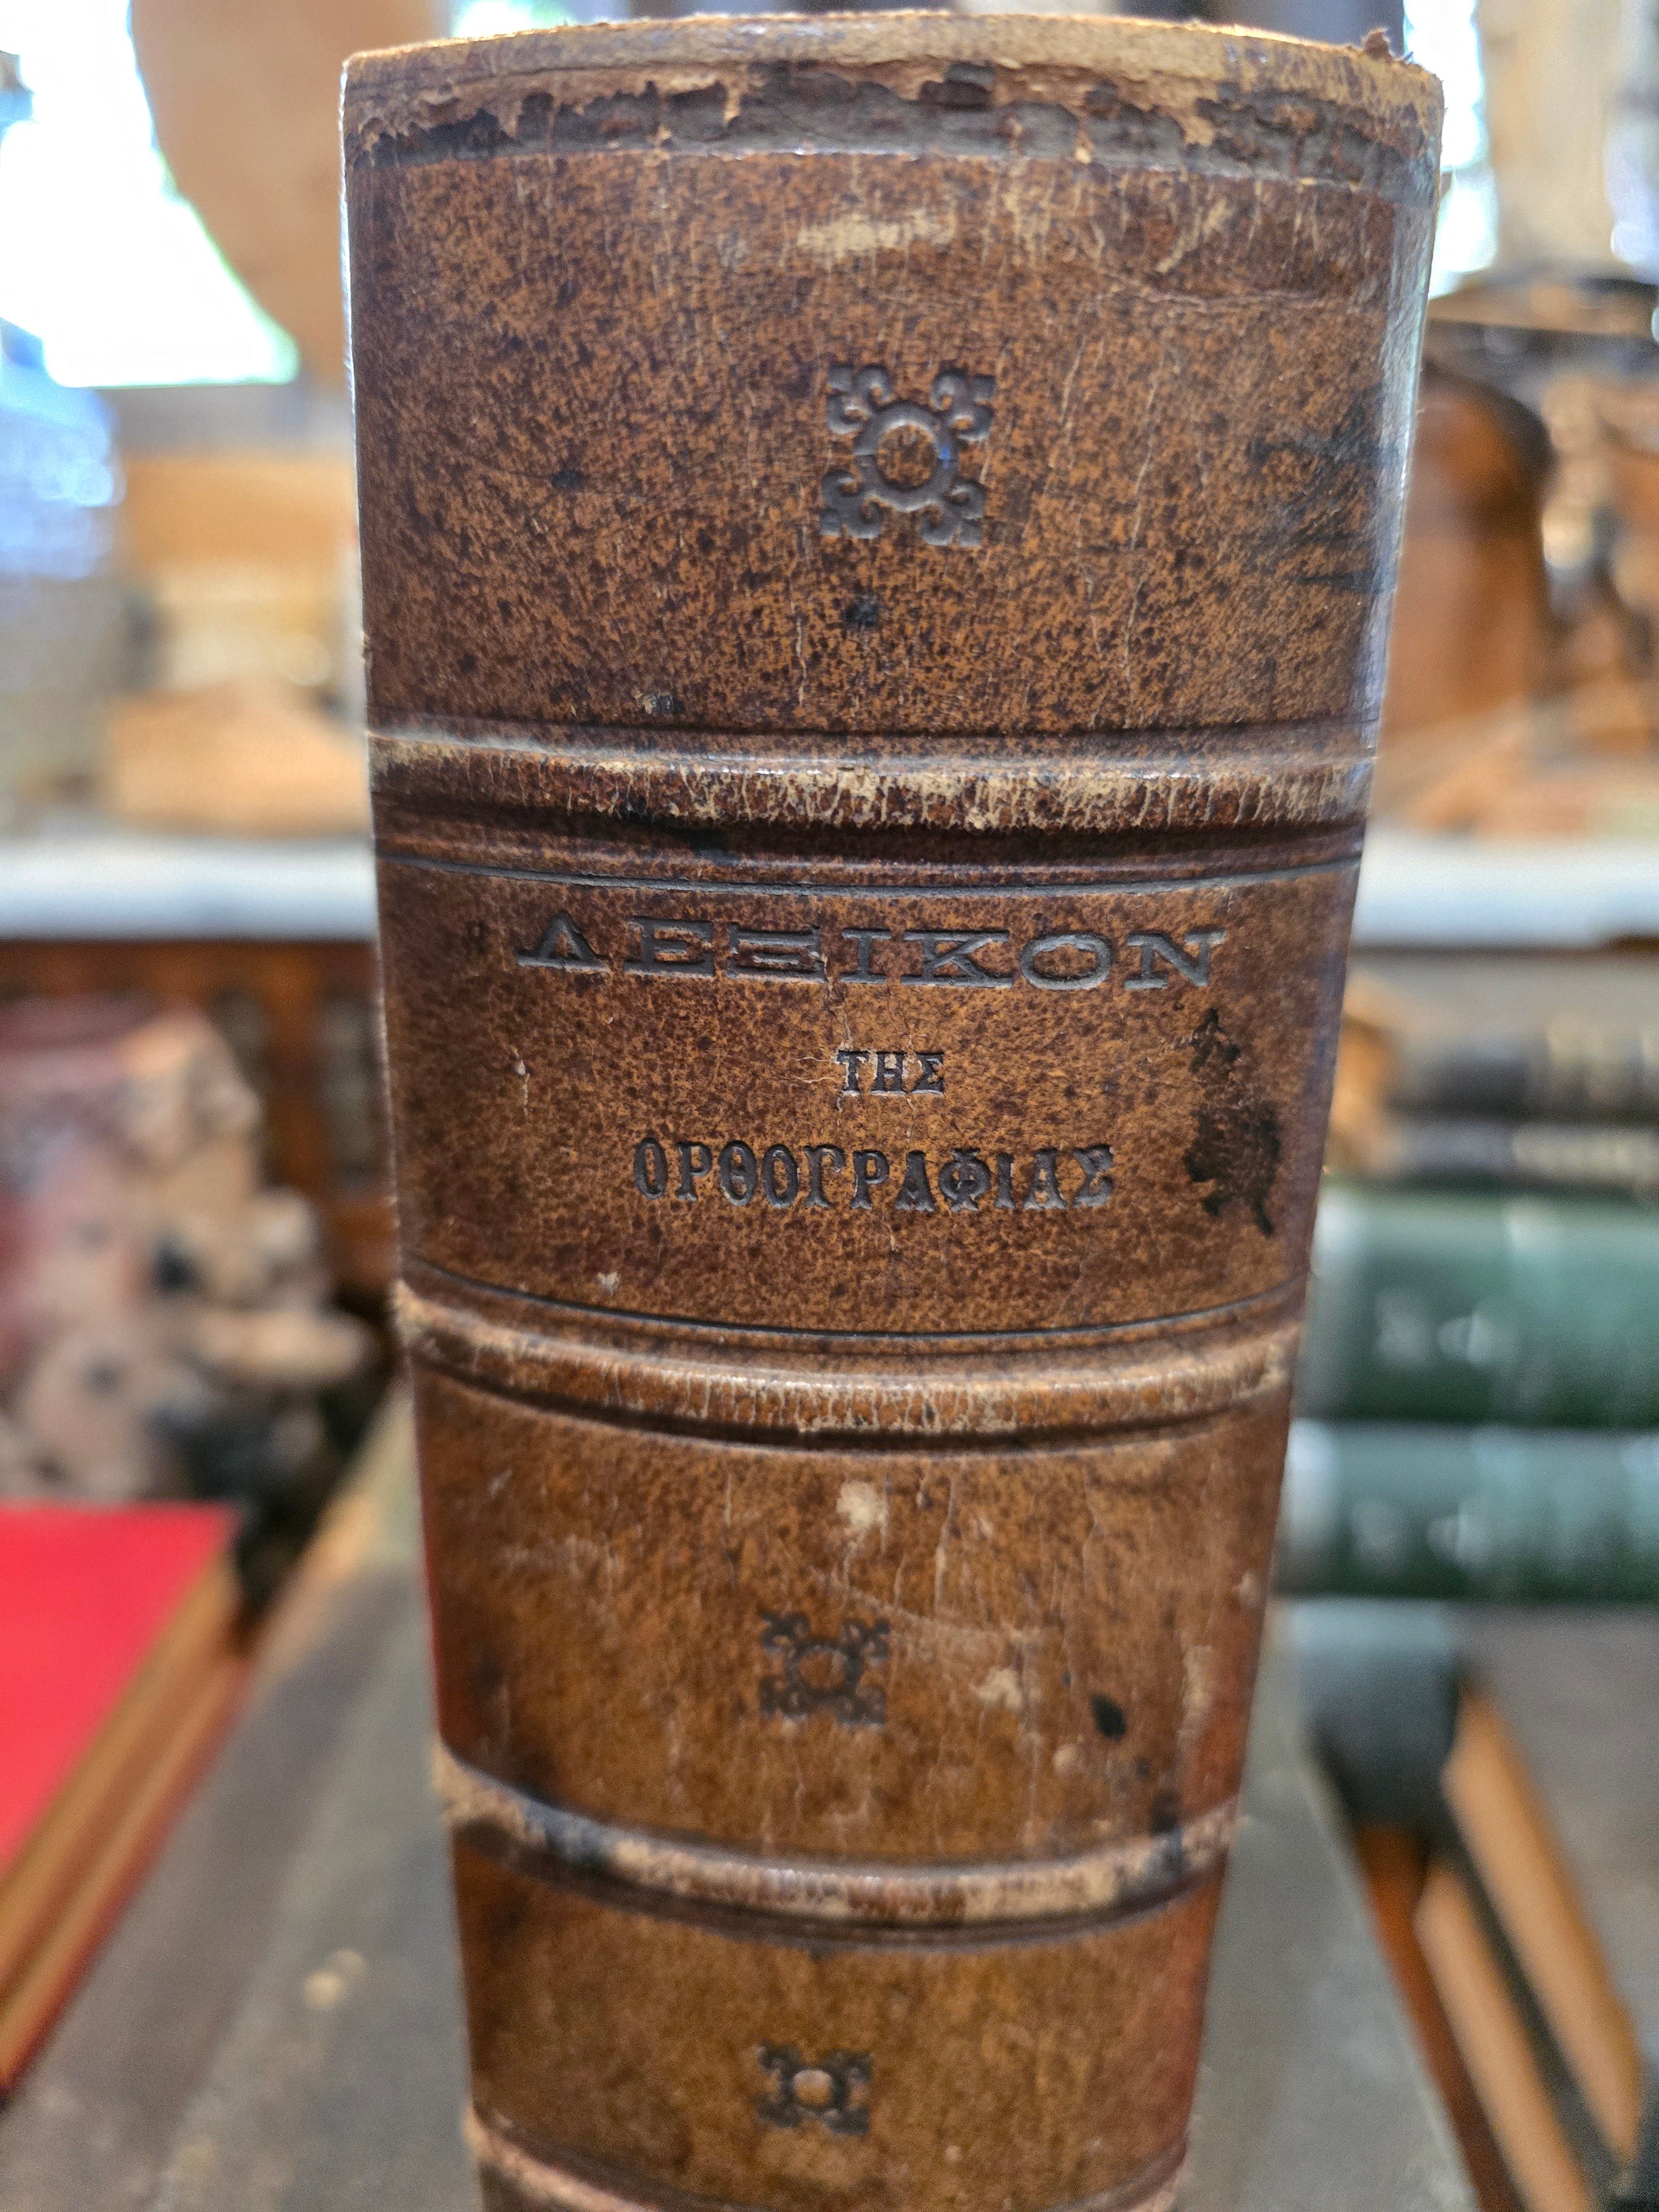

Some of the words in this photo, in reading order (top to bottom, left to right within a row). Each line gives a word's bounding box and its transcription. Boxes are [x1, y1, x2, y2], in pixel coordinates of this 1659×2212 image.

[517, 910, 1227, 990] ΛΕΞΙΚΟΝ
[835, 1050, 945, 1096] ΤΗΣ
[633, 1136, 1114, 1212] ΟΡΘΟΓΡΑΦΙΑΣ
